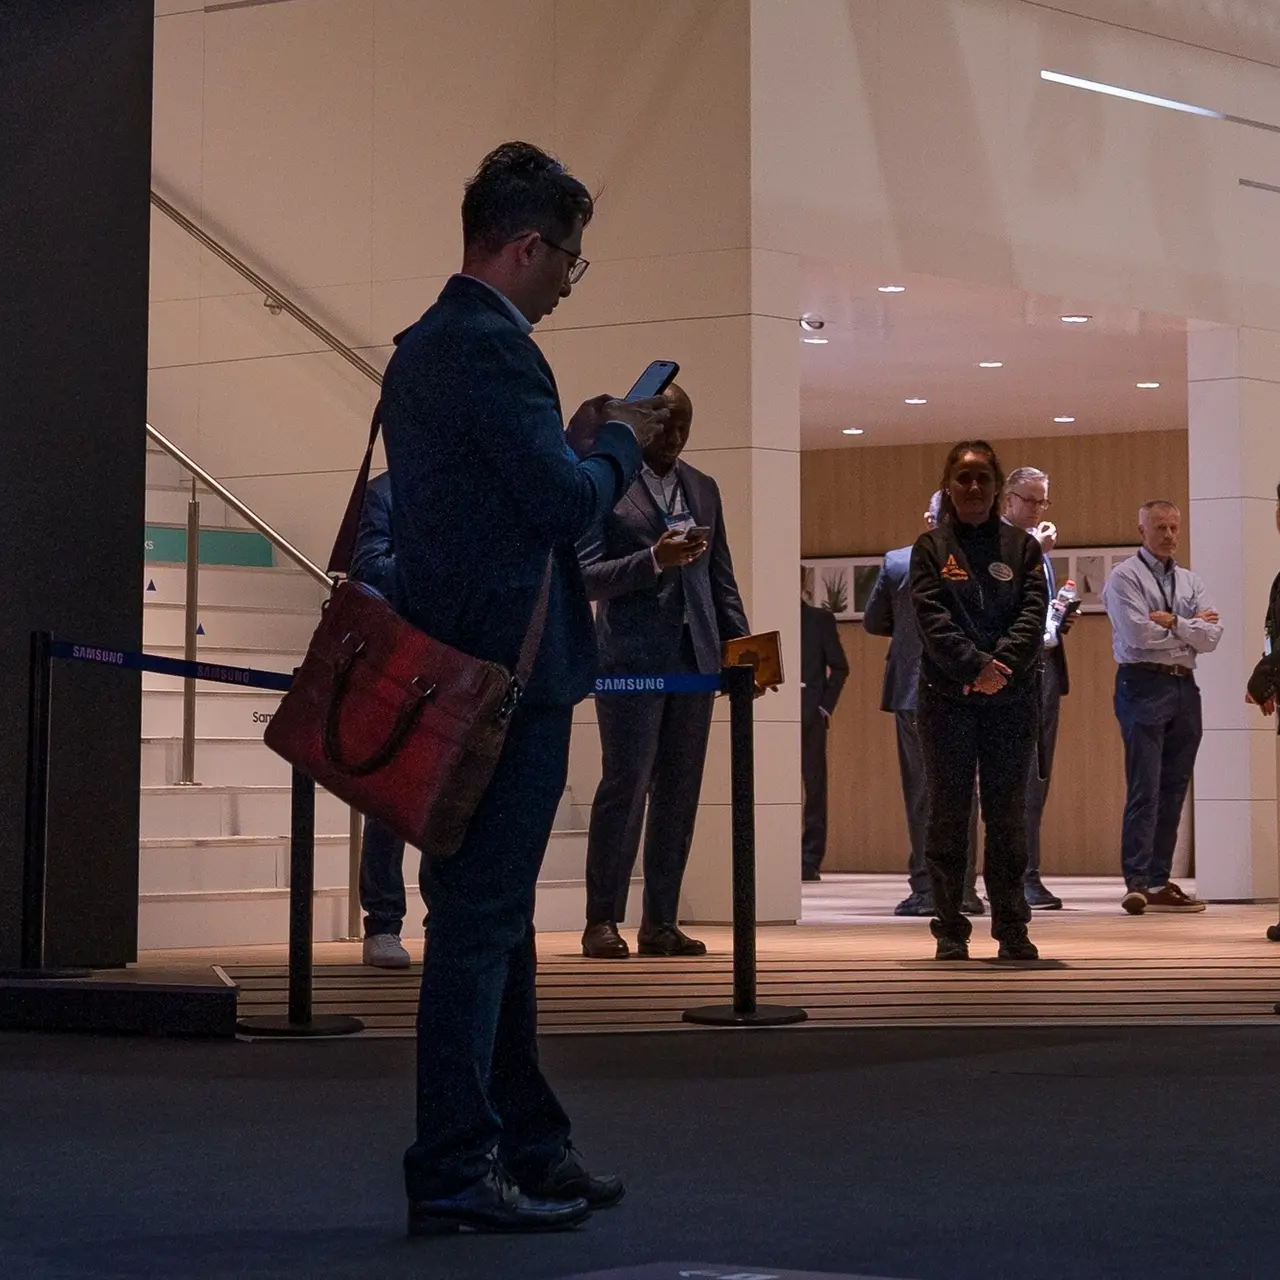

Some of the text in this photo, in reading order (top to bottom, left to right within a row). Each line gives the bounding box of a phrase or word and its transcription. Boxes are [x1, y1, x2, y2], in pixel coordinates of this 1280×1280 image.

[72, 644, 124, 665] SAMSUNG
[196, 665, 250, 684] SAMSUNG
[595, 677, 665, 691] SAMSUNG
